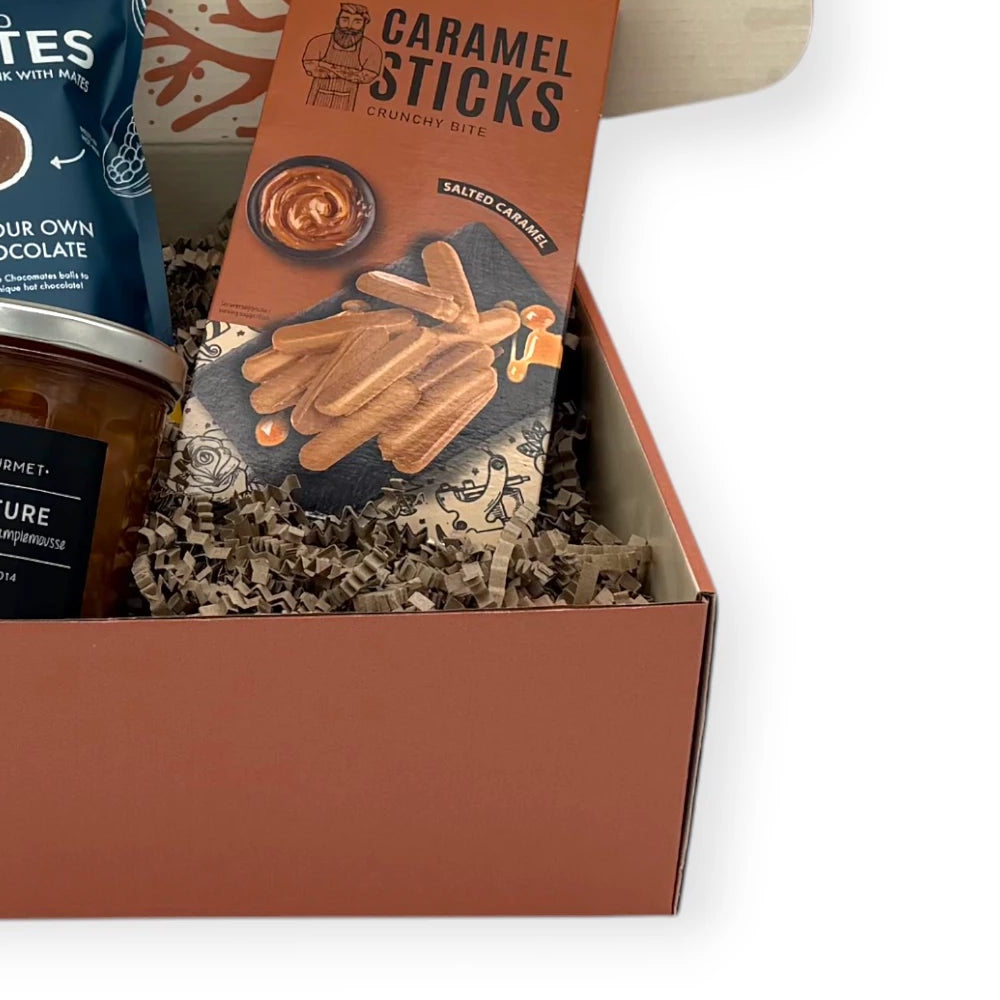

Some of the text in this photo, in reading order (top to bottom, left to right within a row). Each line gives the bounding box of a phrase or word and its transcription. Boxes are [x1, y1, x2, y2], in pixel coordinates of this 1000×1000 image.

[382, 8, 572, 77] CARAMEL
[18, 69, 53, 81] WITH
[59, 69, 90, 92] MATES
[370, 51, 563, 133] STICKS
[367, 106, 488, 137] CRUNCHY BITE
[40, 219, 95, 238] OWN
[444, 182, 548, 248] SALTED CARAMEL
[4, 272, 57, 283] Chocomates
[58, 271, 79, 280] balls
[81, 272, 89, 280] to
[23, 282, 37, 291] hot
